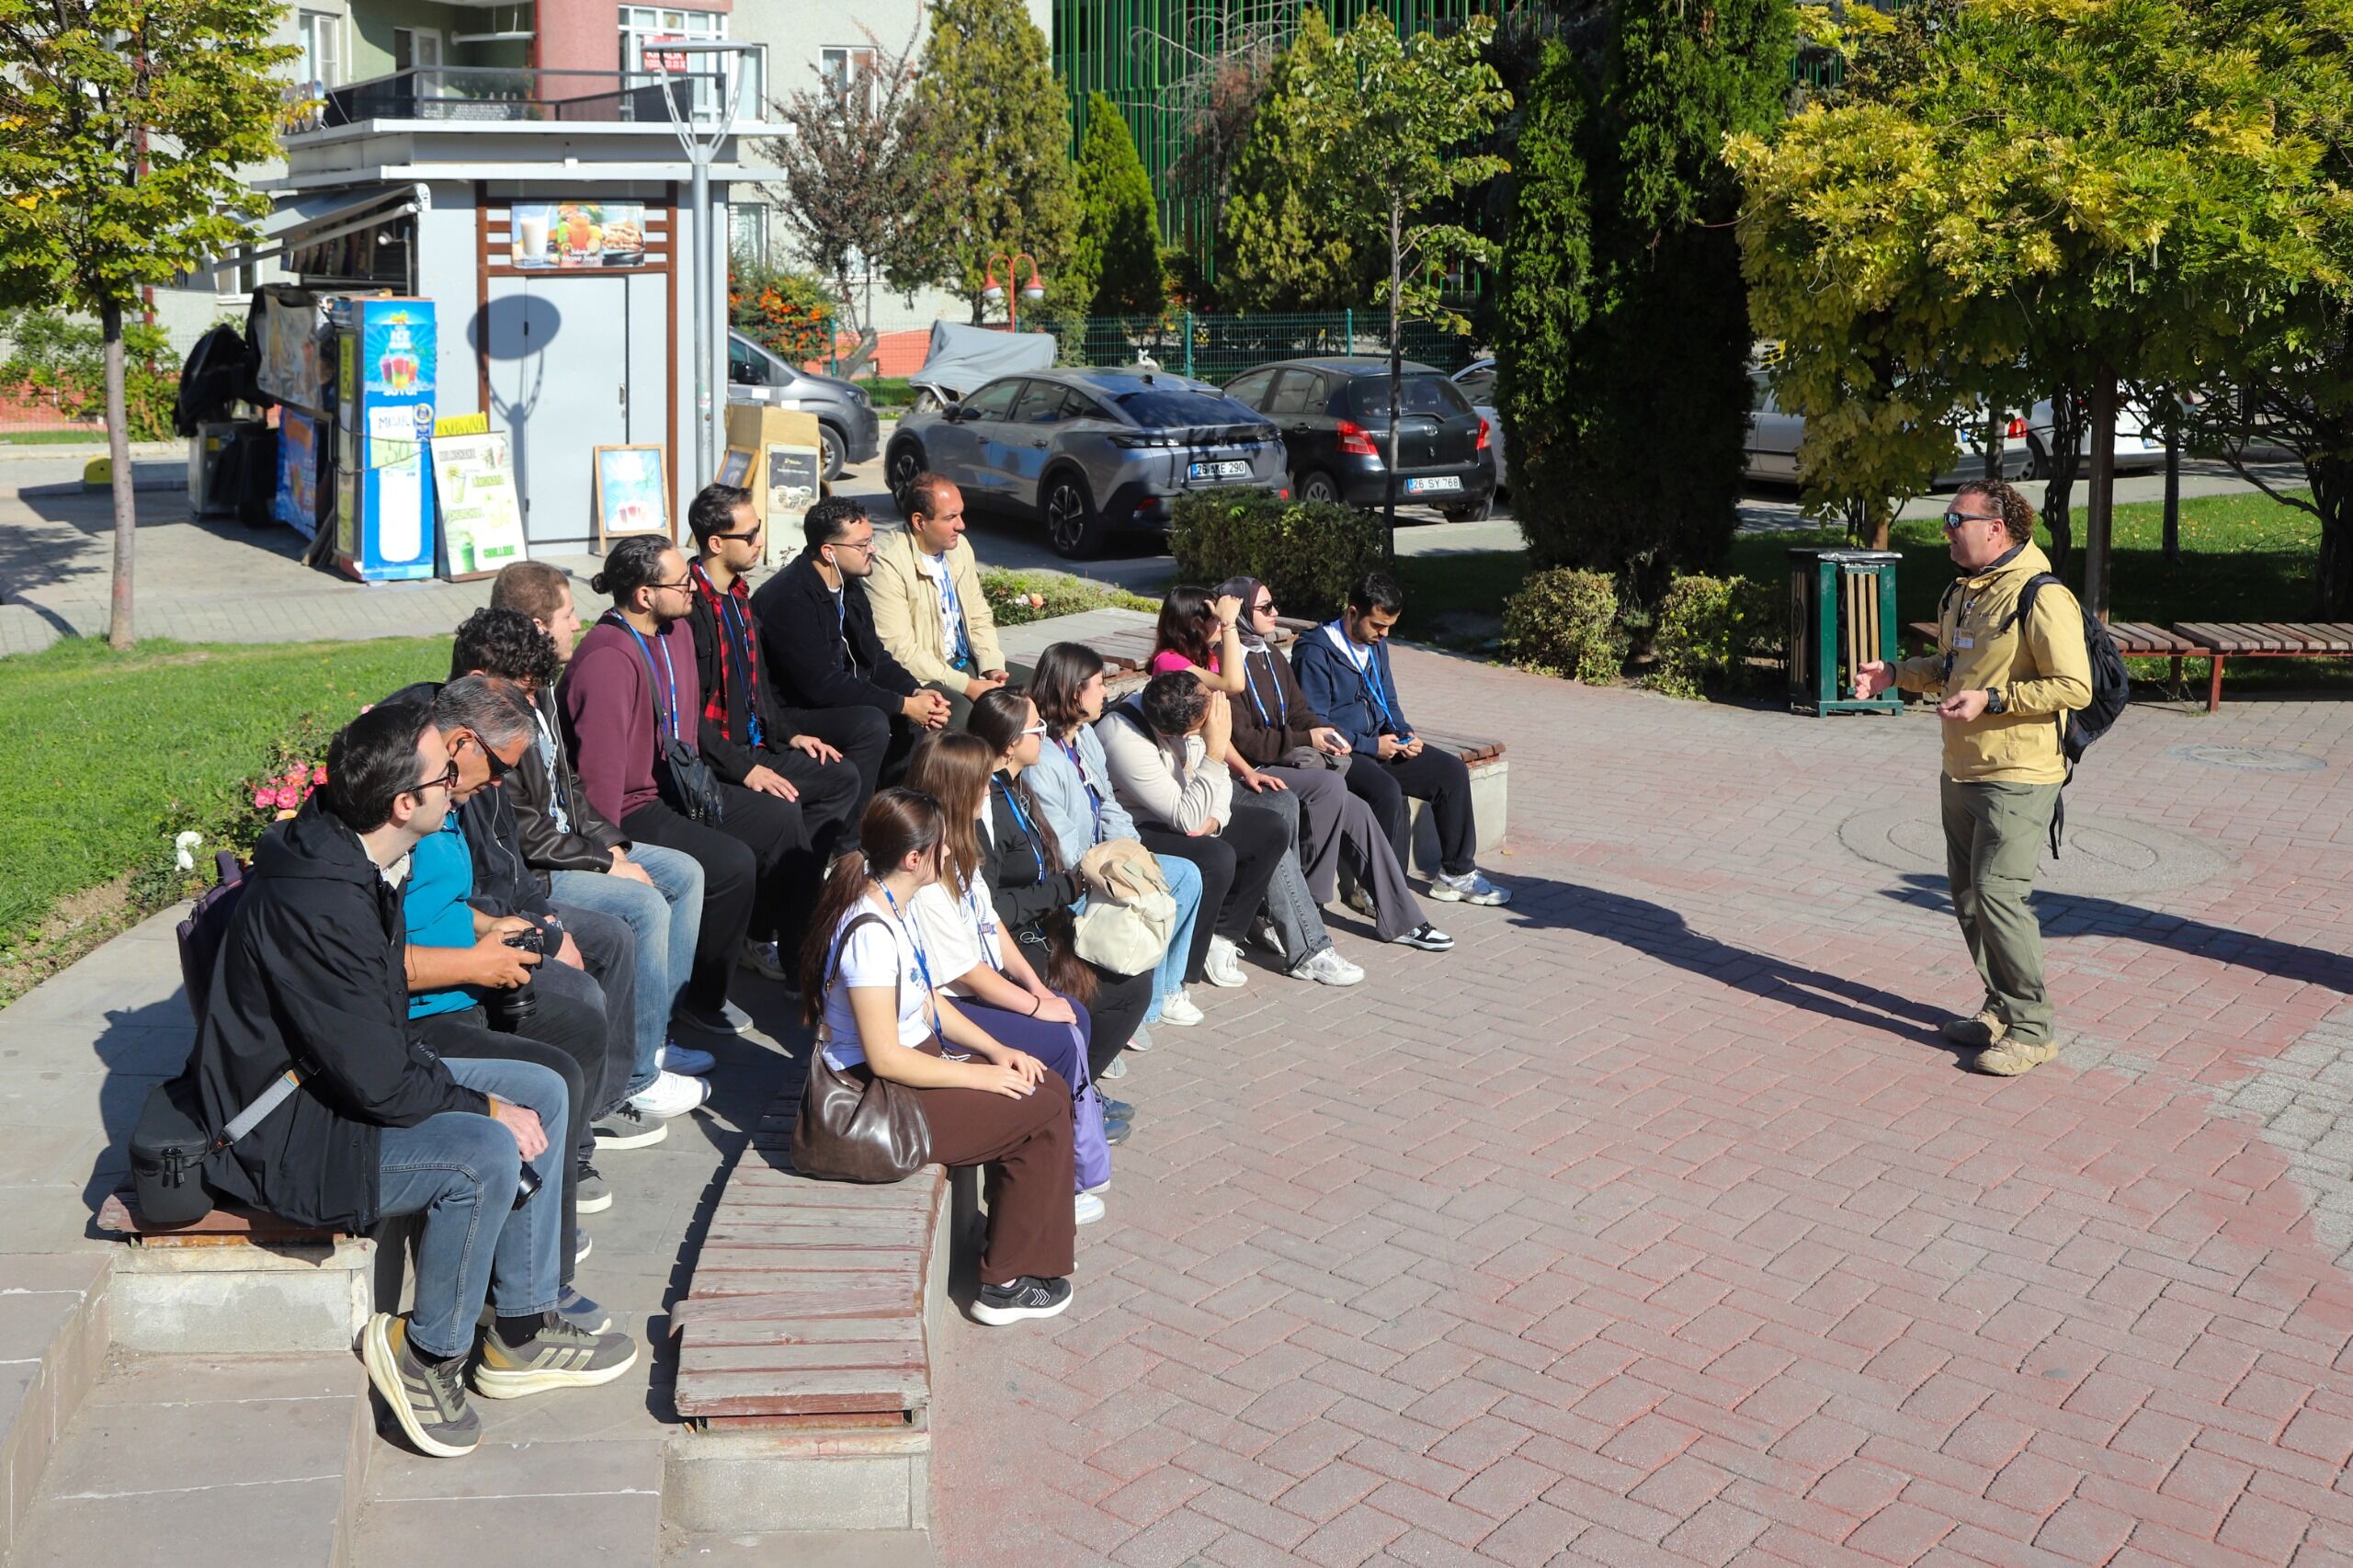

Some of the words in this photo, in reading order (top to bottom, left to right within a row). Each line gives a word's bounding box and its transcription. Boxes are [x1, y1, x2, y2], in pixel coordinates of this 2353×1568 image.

[1197, 463, 1208, 475] 26
[1211, 463, 1226, 474] AKE
[1229, 461, 1245, 473] 290
[1413, 479, 1425, 489] 26
[1427, 479, 1440, 488] SY
[1442, 477, 1459, 487] 768
